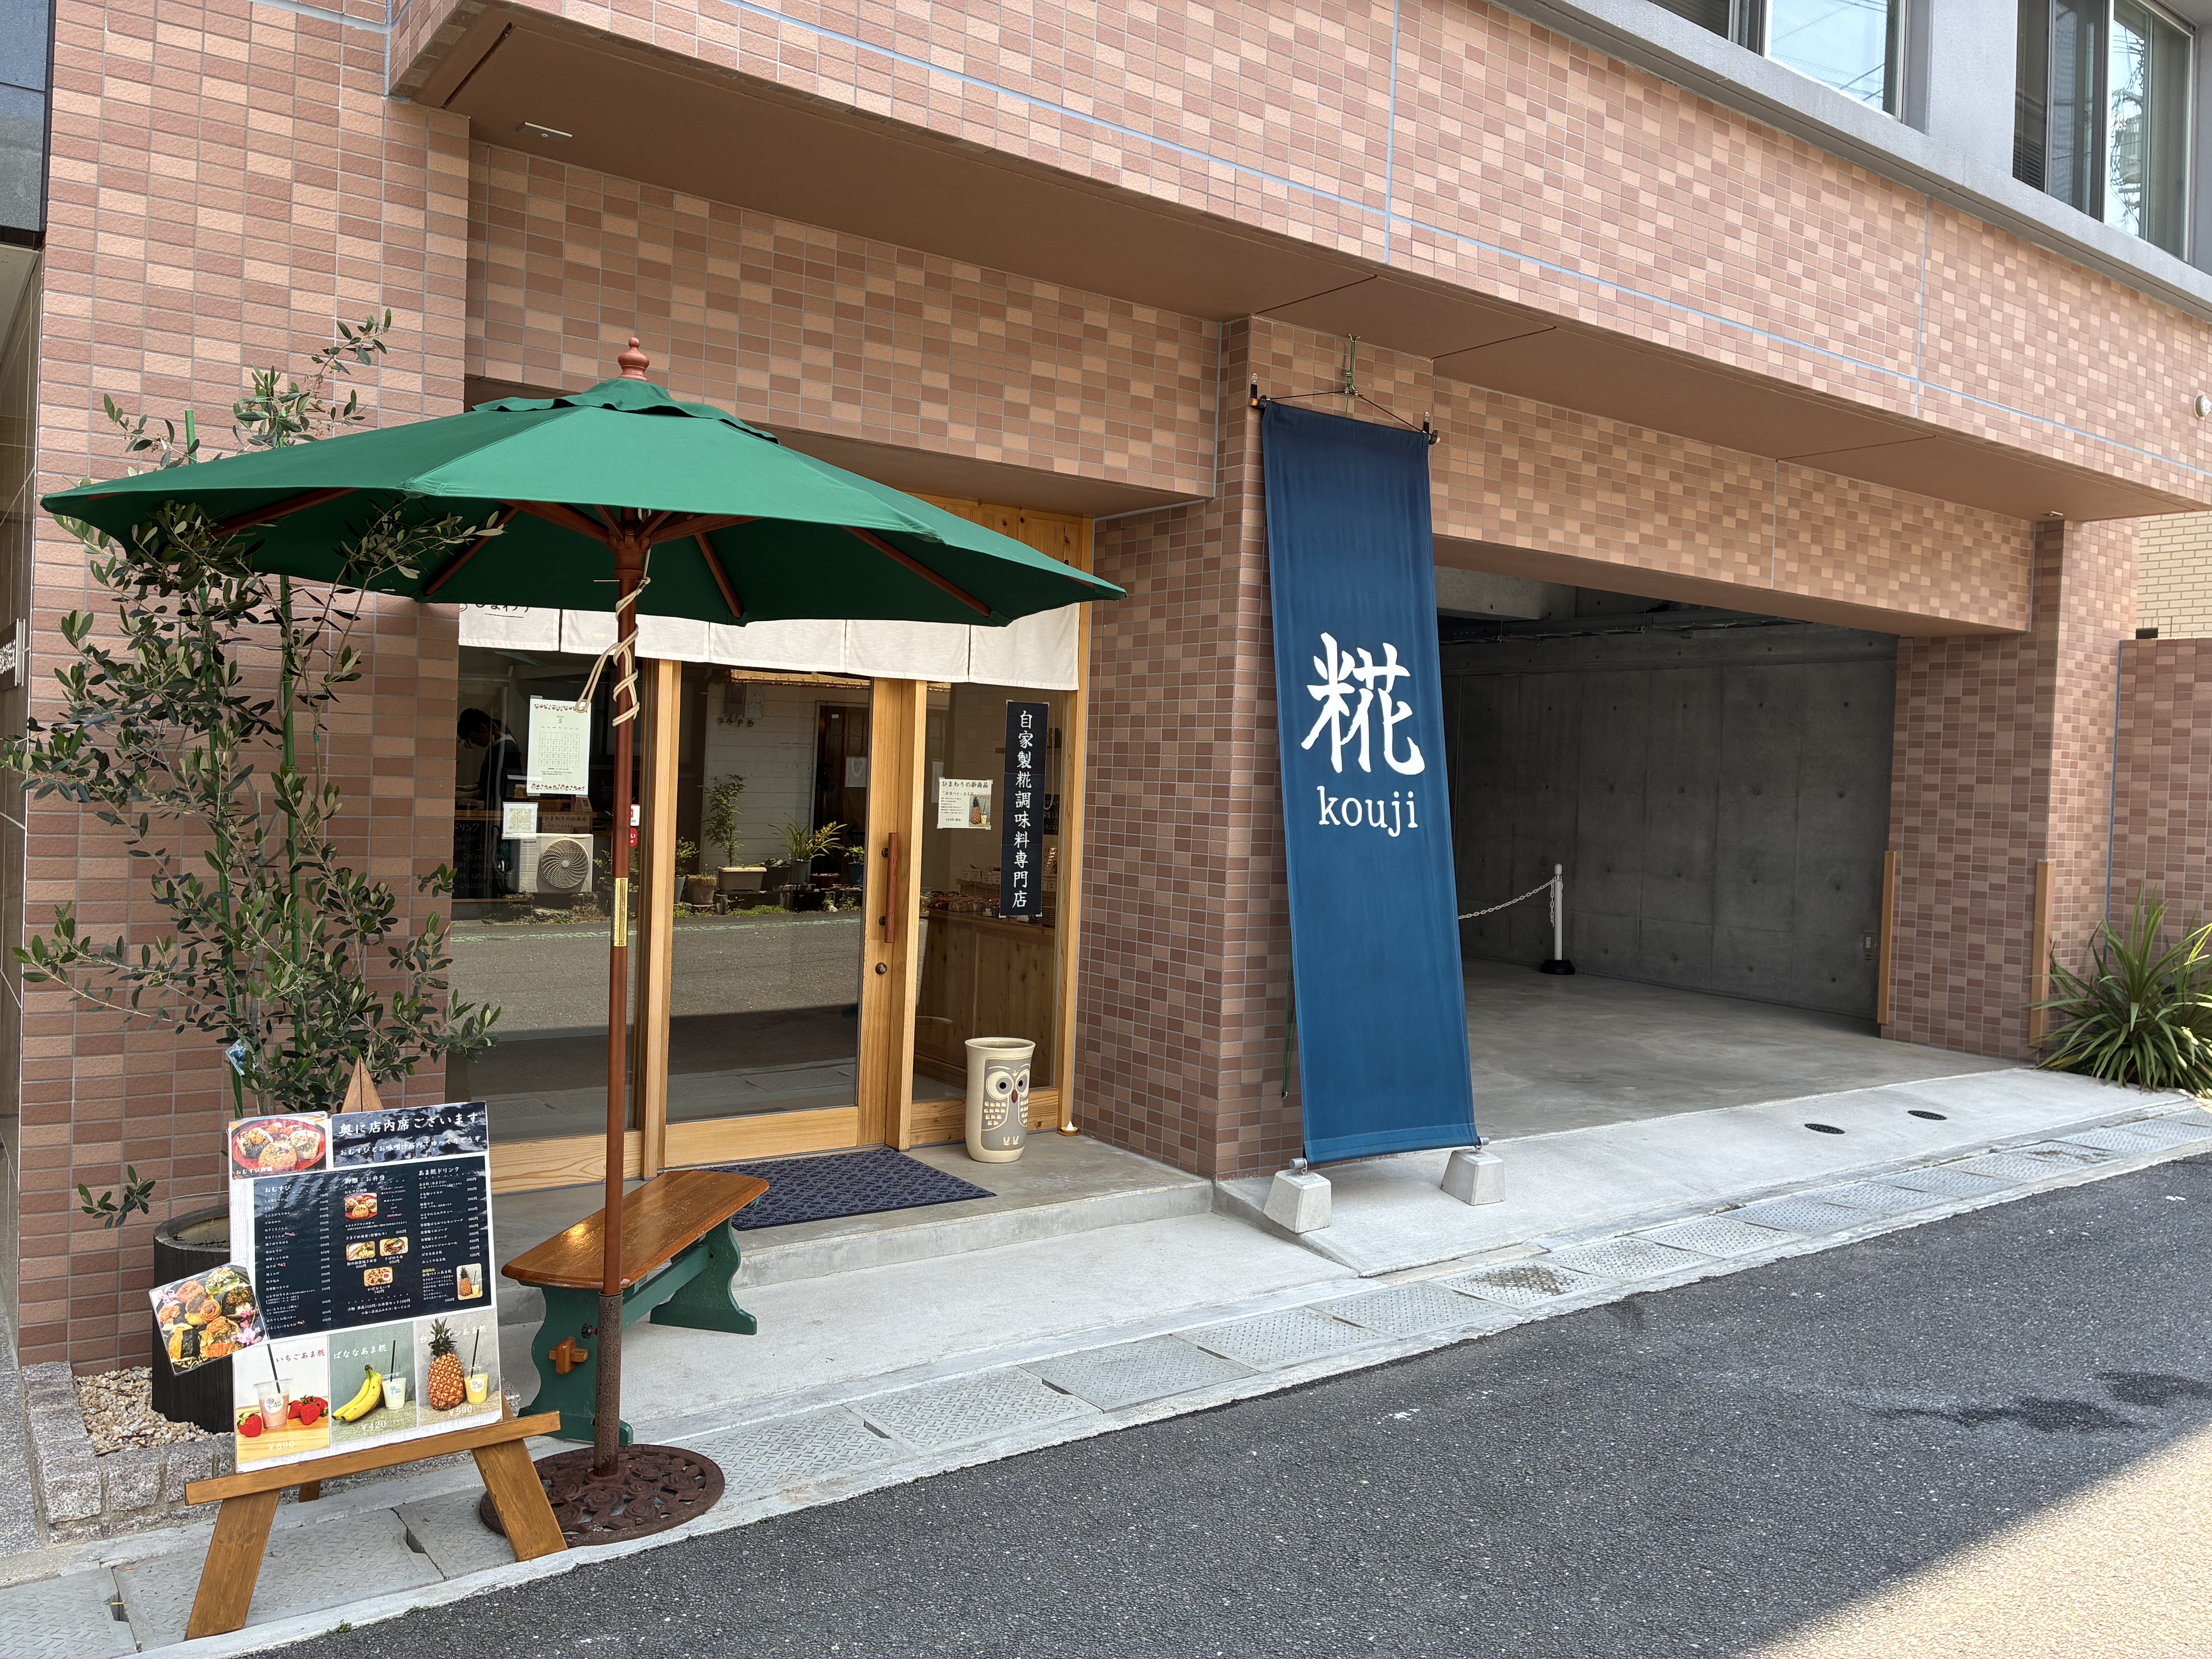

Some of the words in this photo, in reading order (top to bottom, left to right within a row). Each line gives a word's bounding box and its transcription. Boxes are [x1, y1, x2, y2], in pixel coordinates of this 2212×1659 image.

[1301, 632, 1425, 775] 糀
[1012, 710, 1033, 908] 自家製糀調味料専門店
[1317, 786, 1418, 837] kouji
[339, 1111, 477, 1137] 奥に店内席ございます
[419, 1166, 459, 1176] あま糀ドリンク
[265, 1184, 292, 1193] おむすび
[275, 1349, 325, 1363] いちごあま糀
[333, 1343, 387, 1360] ばななあま糀
[448, 1405, 473, 1416] ¥590
[361, 1420, 386, 1431] ¥420
[268, 1440, 295, 1452] ¥690
